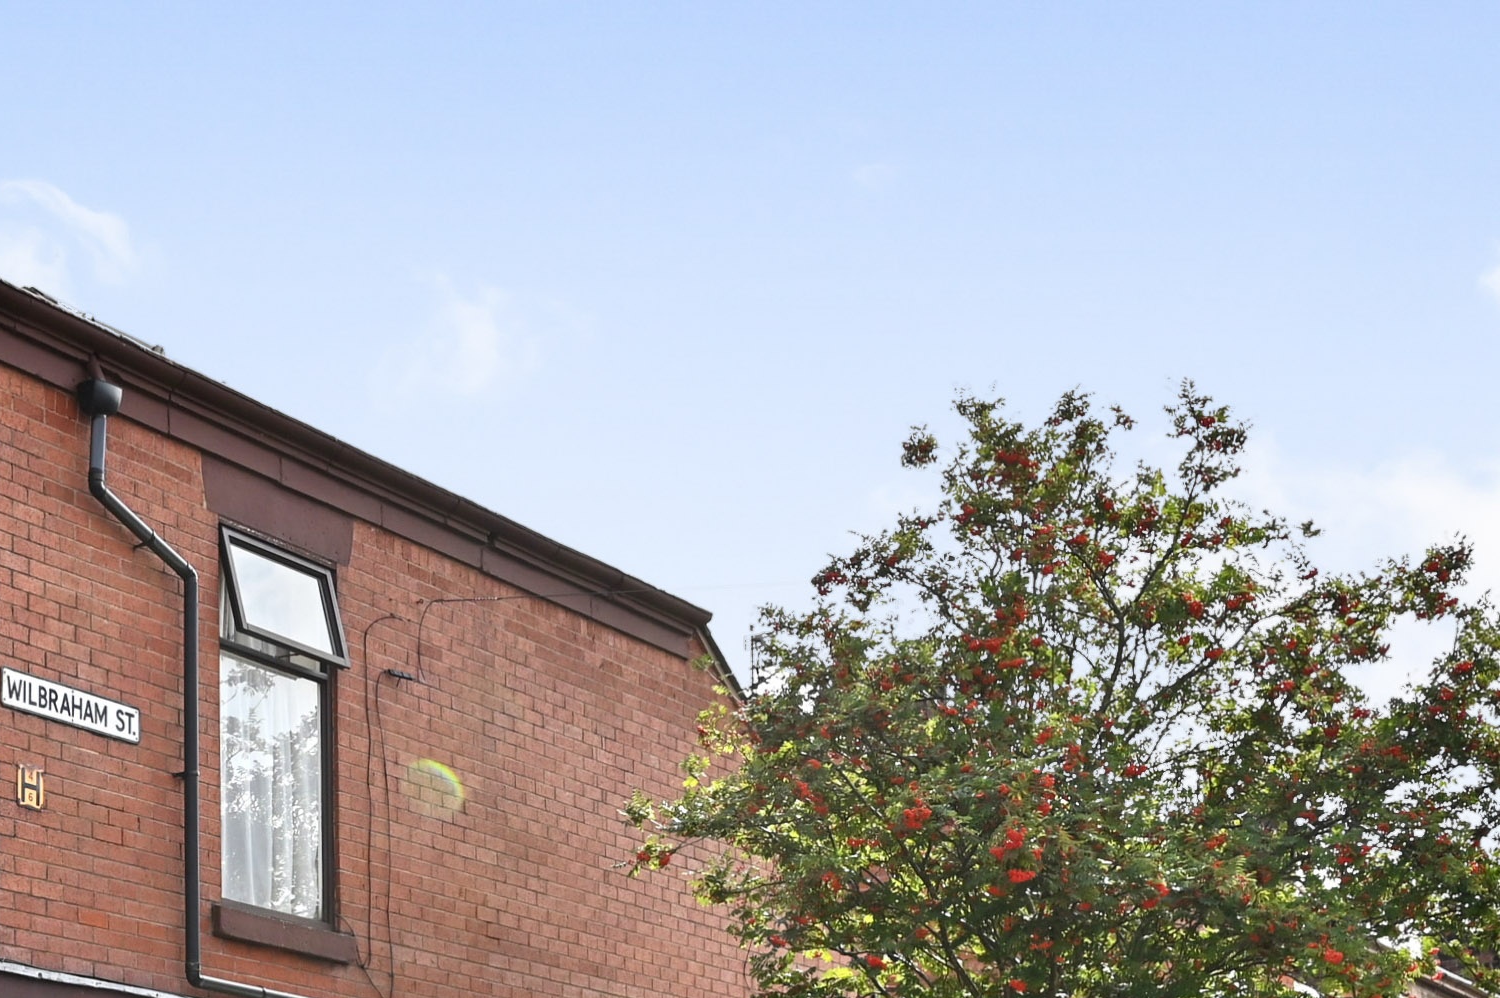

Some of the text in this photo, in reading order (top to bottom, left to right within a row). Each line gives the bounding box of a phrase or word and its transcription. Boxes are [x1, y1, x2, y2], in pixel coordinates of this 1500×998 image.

[6, 675, 137, 736] WILBRAHAM ST.
[21, 767, 40, 806] H
